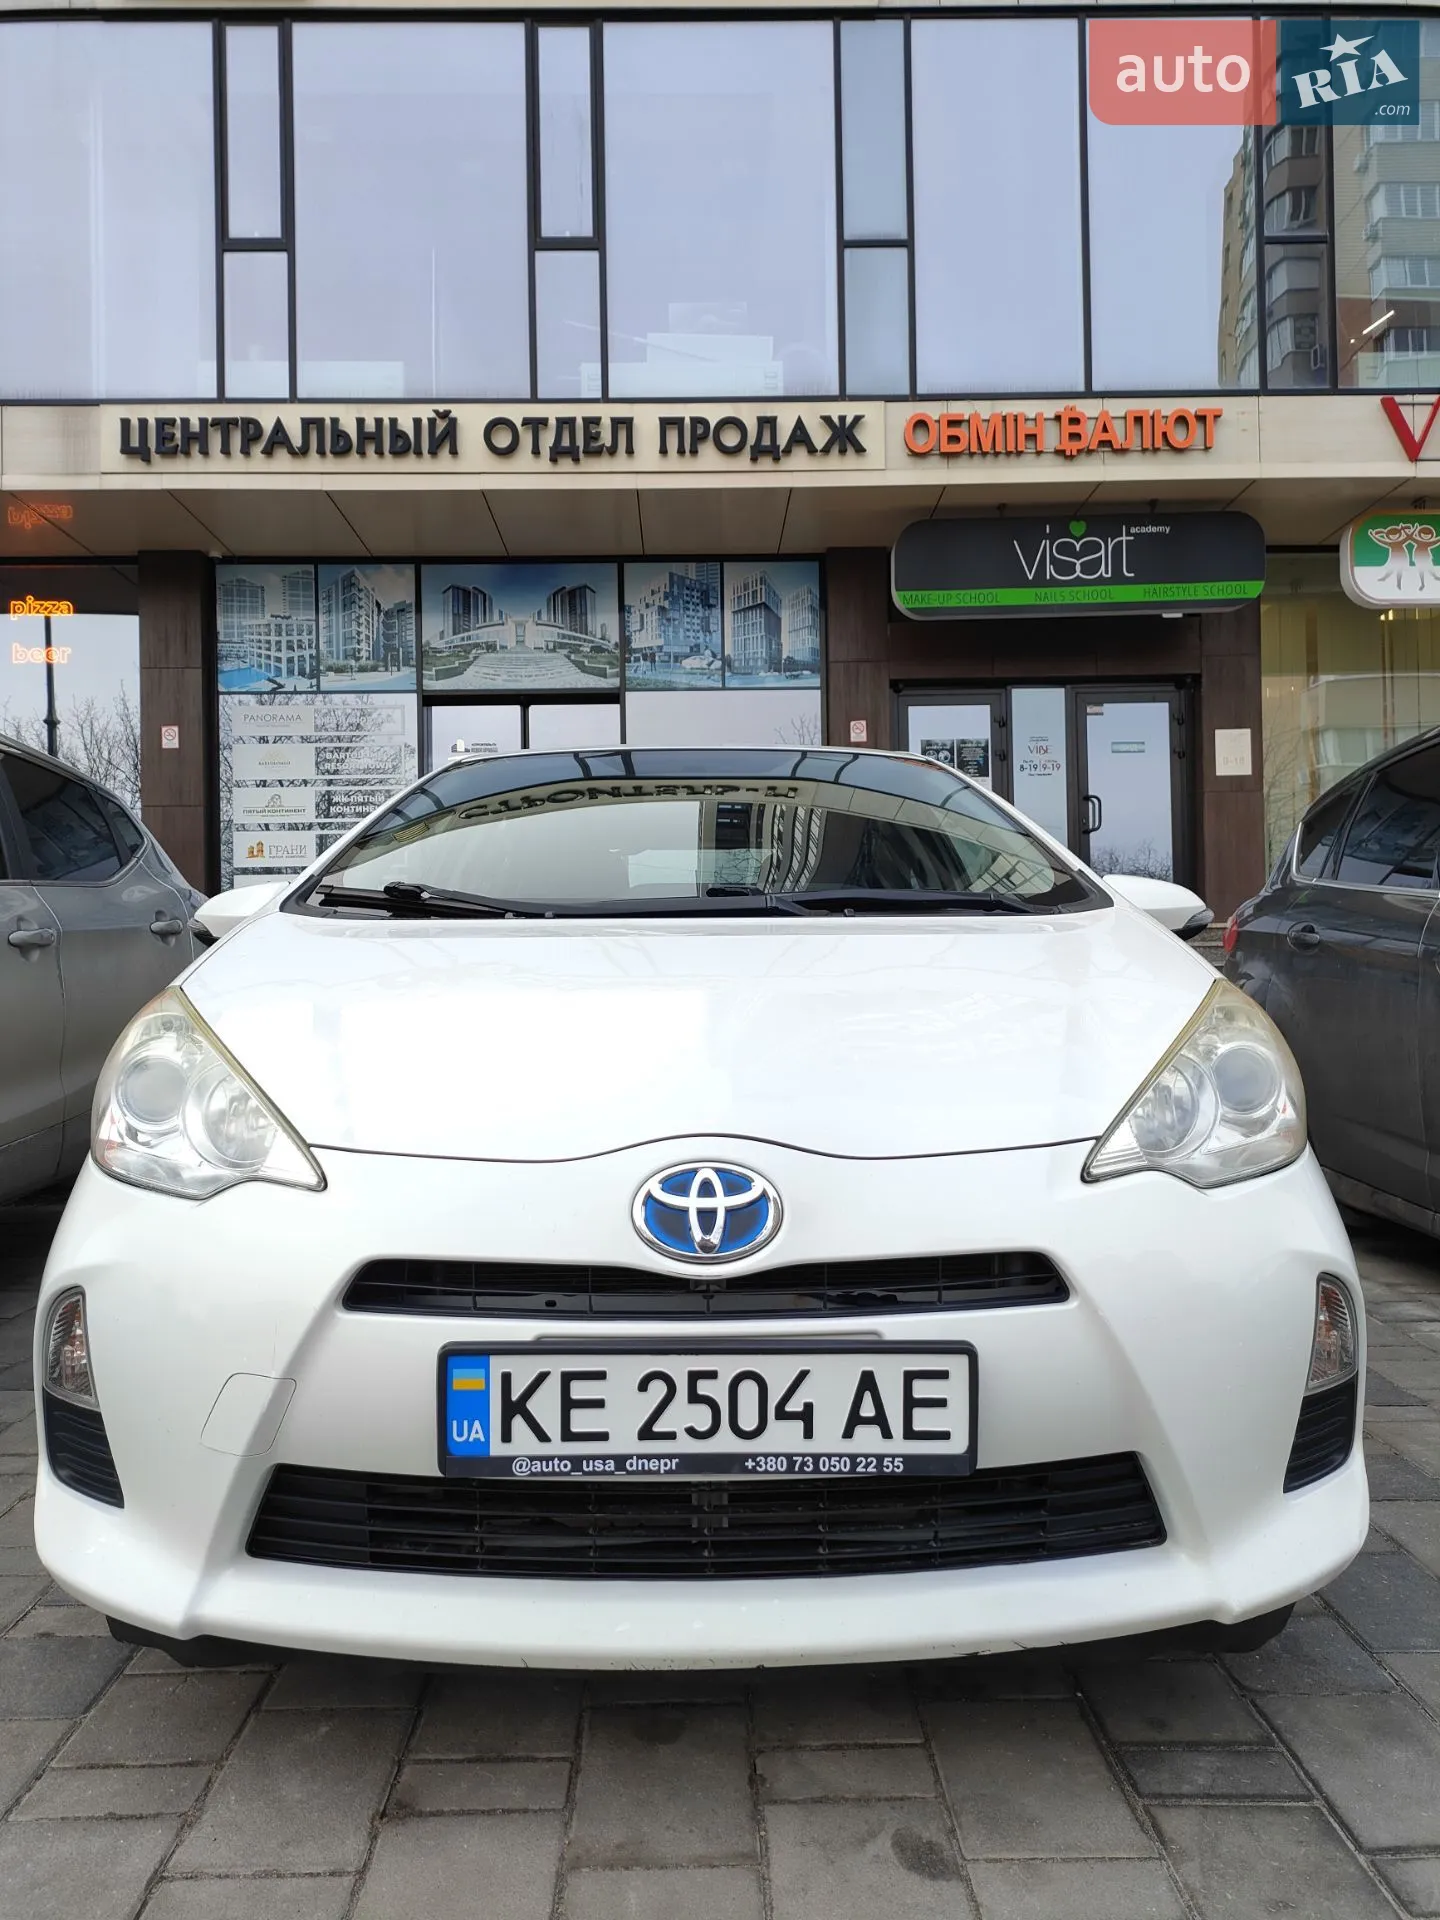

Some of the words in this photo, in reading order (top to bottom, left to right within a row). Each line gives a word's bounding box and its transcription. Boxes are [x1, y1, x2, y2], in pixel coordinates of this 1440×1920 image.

[119, 408, 459, 464] ЦЕНТРАЛЬНЫЙ
[483, 415, 635, 464] ОТДЕЛ
[658, 414, 868, 464] ПРОДАЖ
[904, 410, 1045, 455] ОБМІН
[1129, 523, 1171, 535] academy
[903, 592, 953, 605] MAKE-UP
[955, 590, 1001, 604] SCHOOL
[1034, 589, 1066, 602] NAILS
[1069, 587, 1114, 601] SCHOOL
[1143, 584, 1199, 599] HAIRSTYLE
[1203, 583, 1249, 597] SCHOOL
[10, 594, 74, 621] pizza
[12, 642, 72, 664] beer
[243, 713, 302, 722] PANORAMA
[268, 844, 307, 855] ГРАНИ
[500, 1368, 610, 1443] KE
[636, 1368, 815, 1442] 2504
[841, 1368, 951, 1441] AE
[452, 1419, 485, 1442] UA
[512, 1457, 679, 1475] @auto_usa_dnepr
[744, 1457, 788, 1473] +380
[793, 1457, 815, 1472] 73
[818, 1457, 852, 1472] 050
[856, 1457, 877, 1472] 22
[882, 1457, 904, 1472] 55
